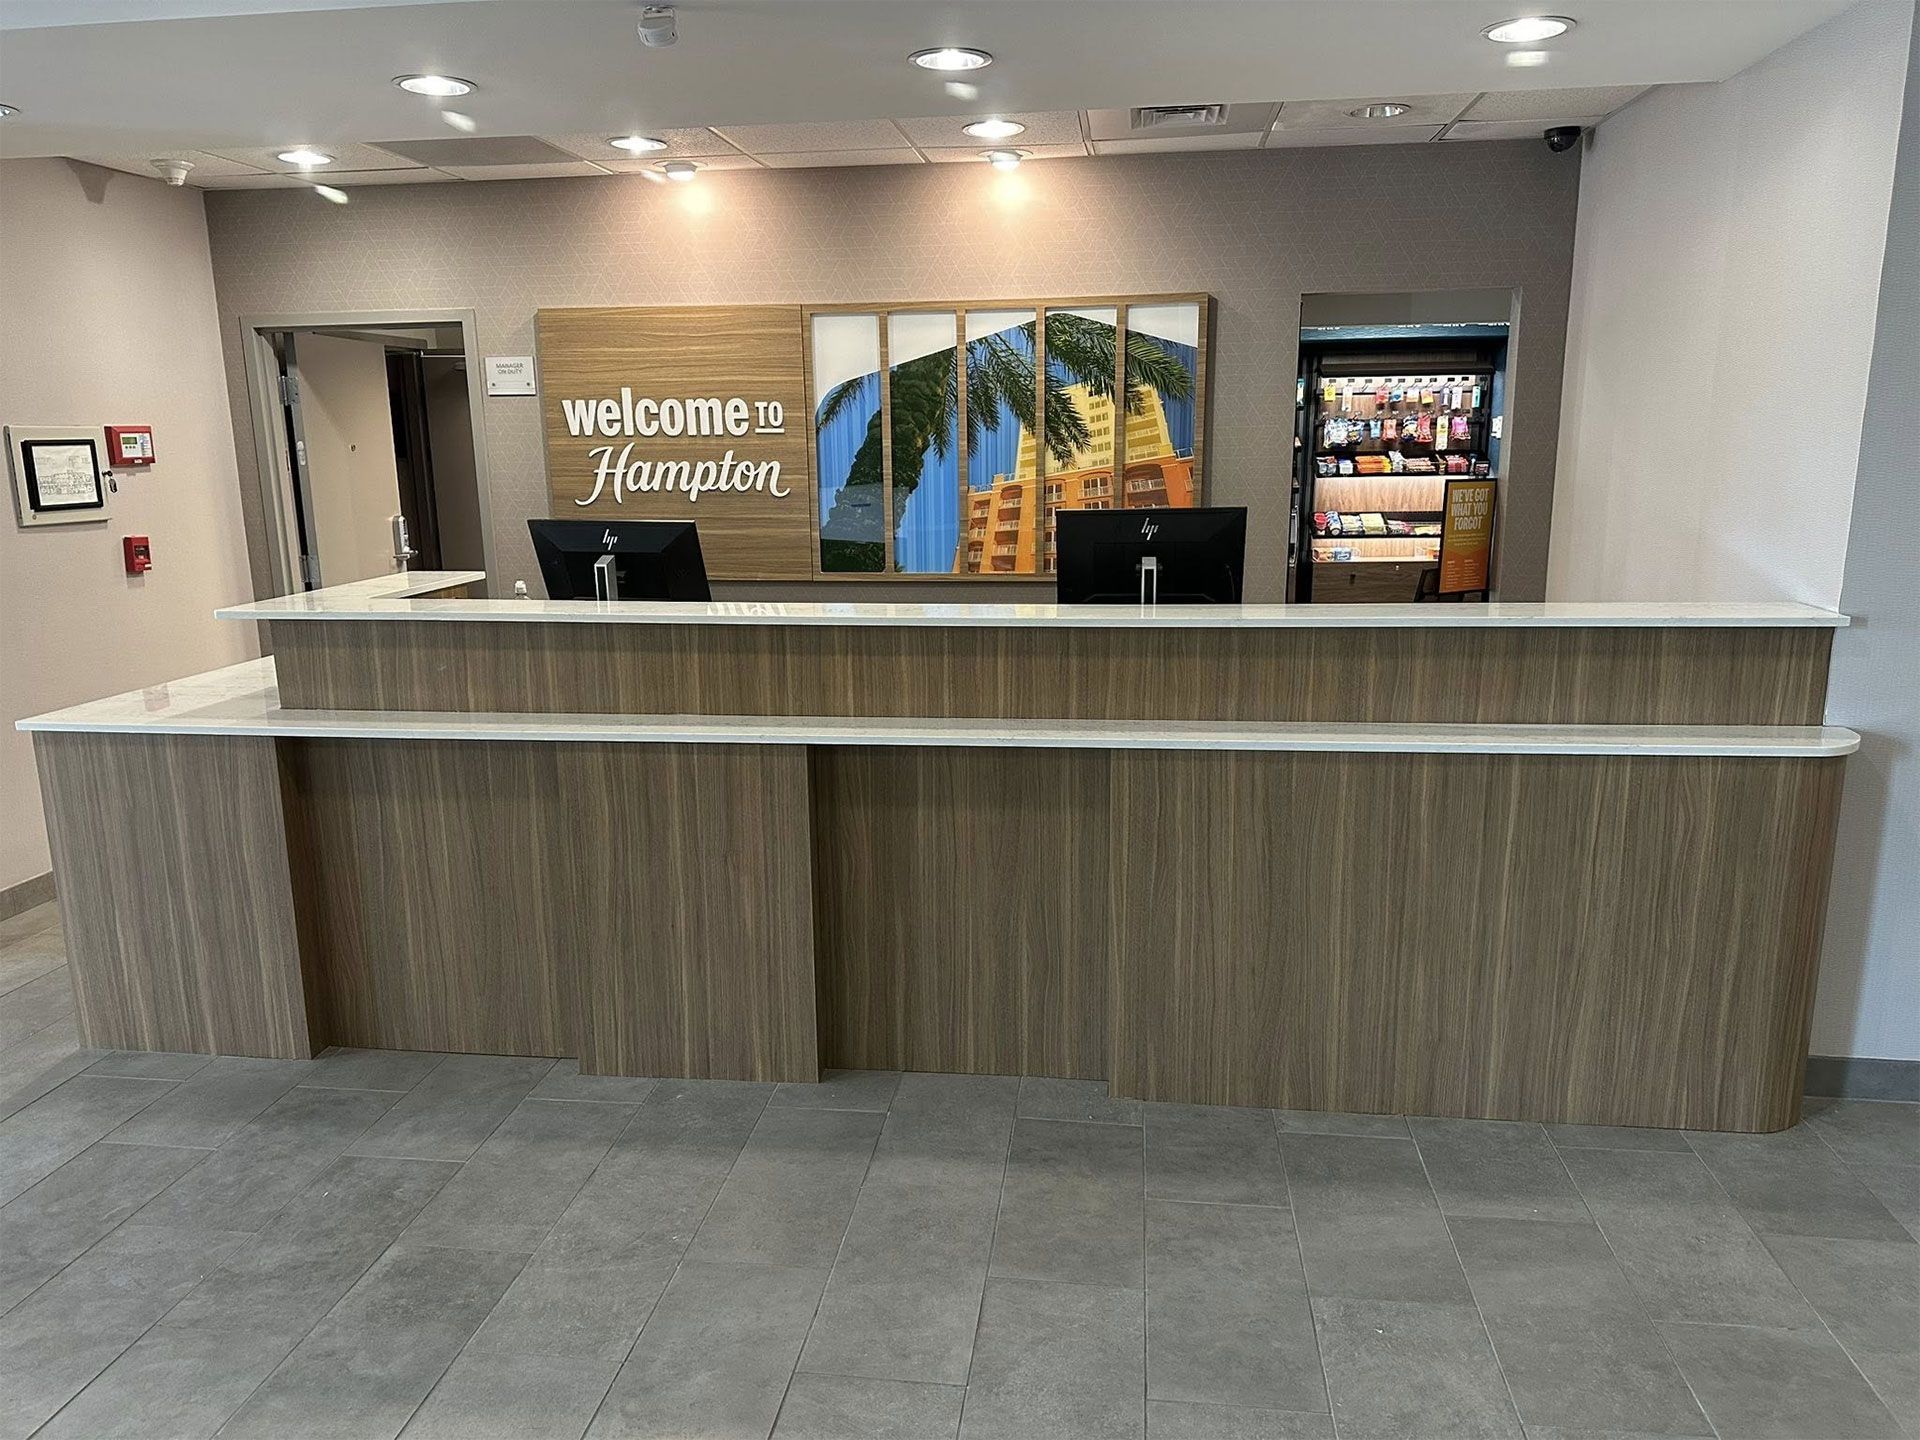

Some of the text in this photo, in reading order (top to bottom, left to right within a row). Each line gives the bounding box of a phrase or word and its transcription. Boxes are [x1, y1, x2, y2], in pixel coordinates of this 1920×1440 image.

[561, 387, 785, 437] welcome TO
[574, 441, 791, 506] Hampton
[1452, 488, 1490, 502] WE'VE GOT
[1451, 502, 1488, 516] WHAT YOU
[1141, 517, 1159, 541] hp
[1454, 516, 1482, 530] FORGOT
[602, 528, 618, 551] hp
